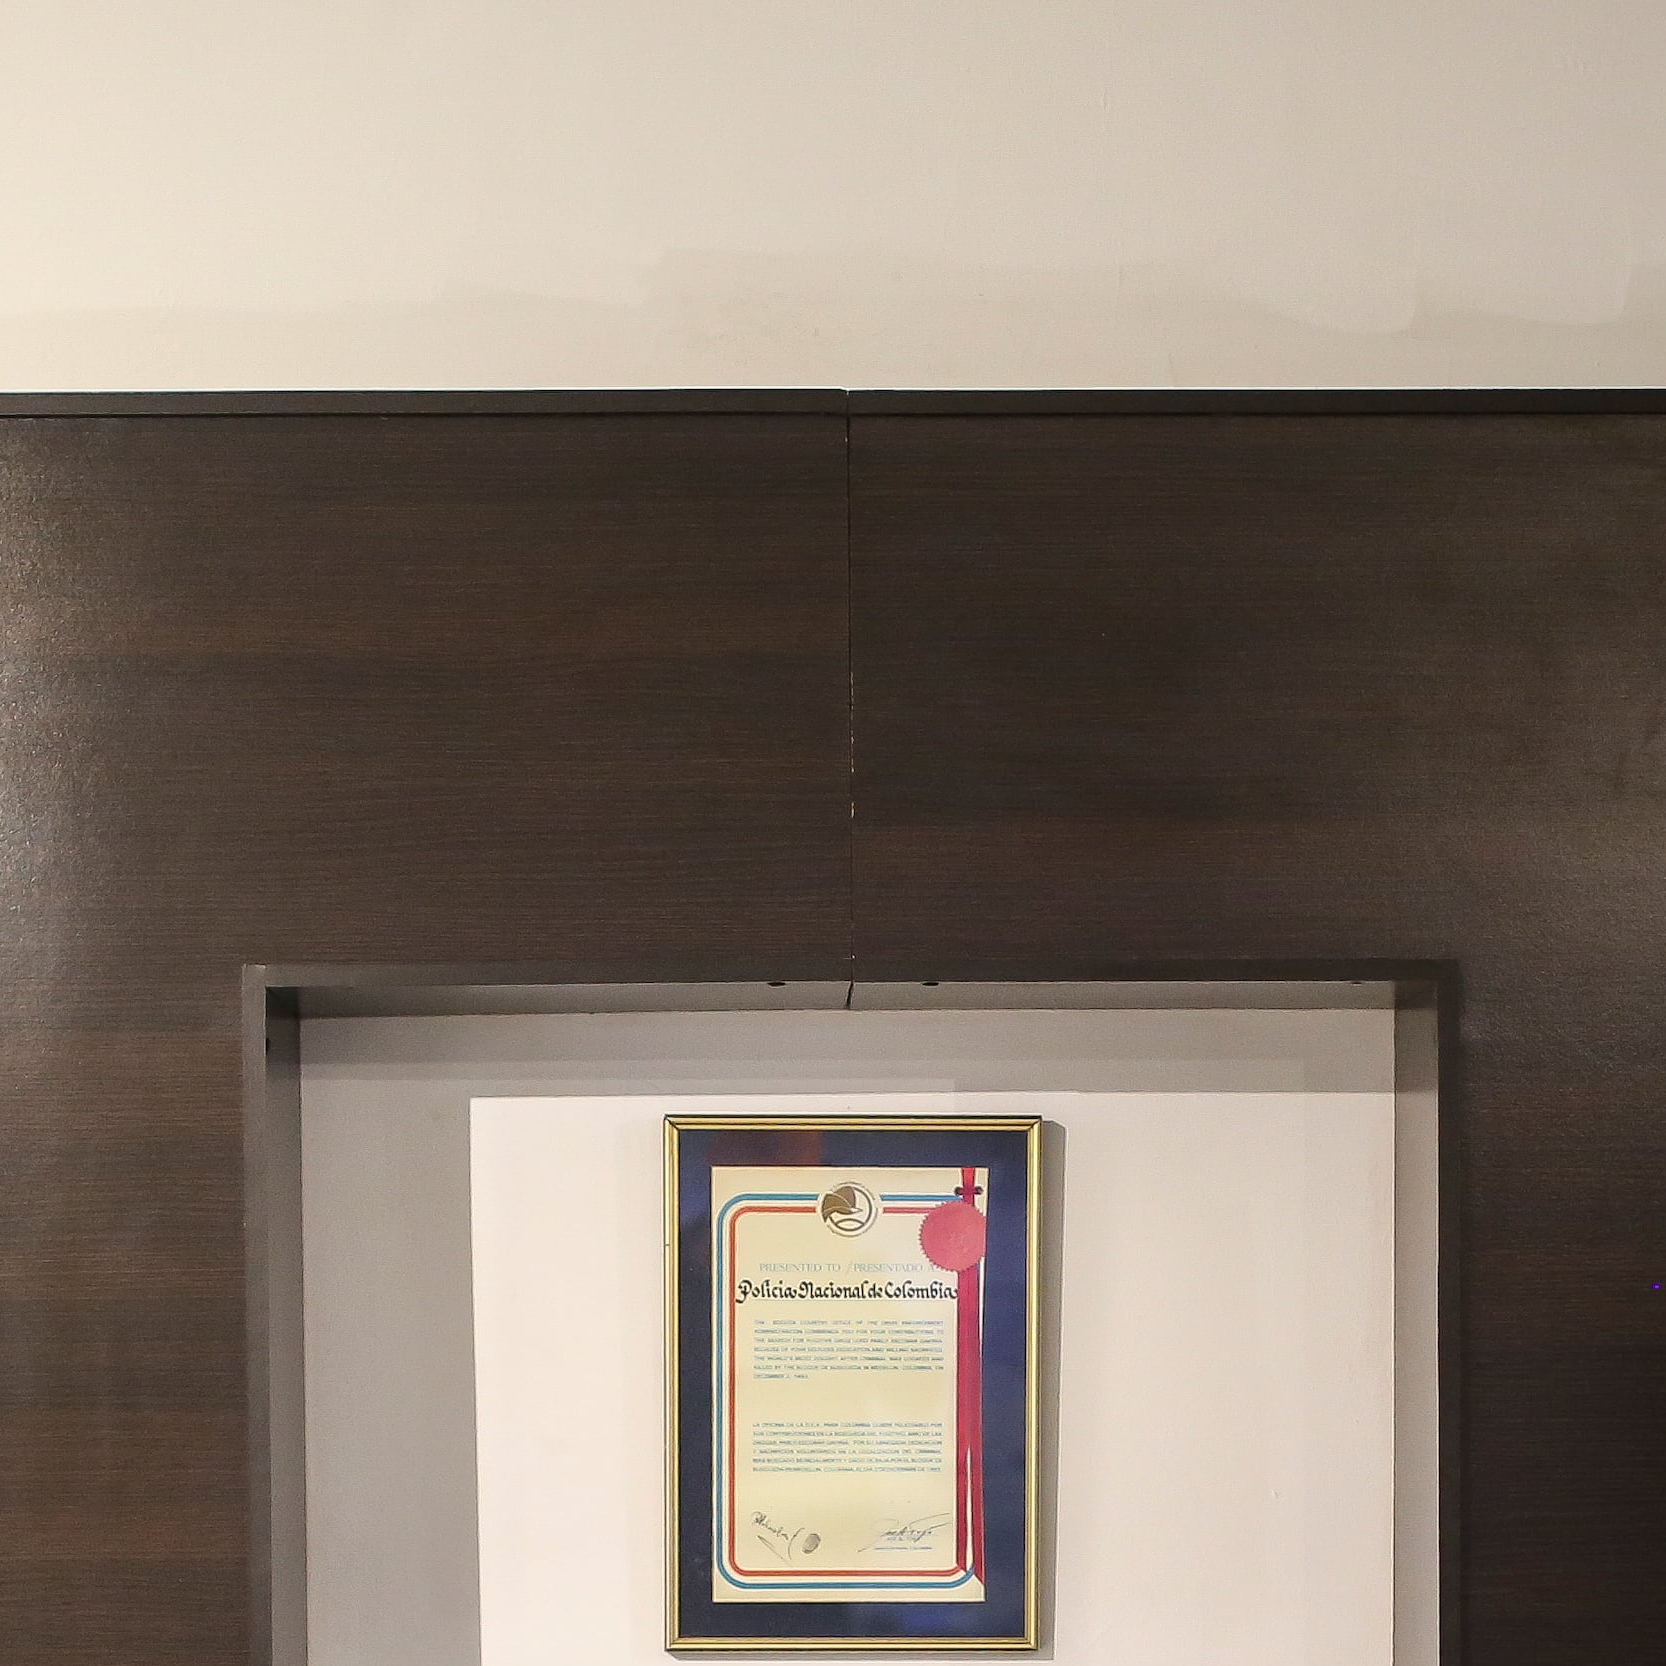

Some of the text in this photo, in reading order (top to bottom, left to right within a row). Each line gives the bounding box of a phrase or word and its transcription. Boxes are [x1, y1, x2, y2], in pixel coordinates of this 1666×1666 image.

[759, 1263, 822, 1273] PRESENTED
[827, 1263, 841, 1273] TO
[853, 1263, 924, 1273] PRESENTADO
[797, 1279, 869, 1299] Nacional
[868, 1280, 884, 1299] de
[884, 1279, 958, 1300] Colombia
